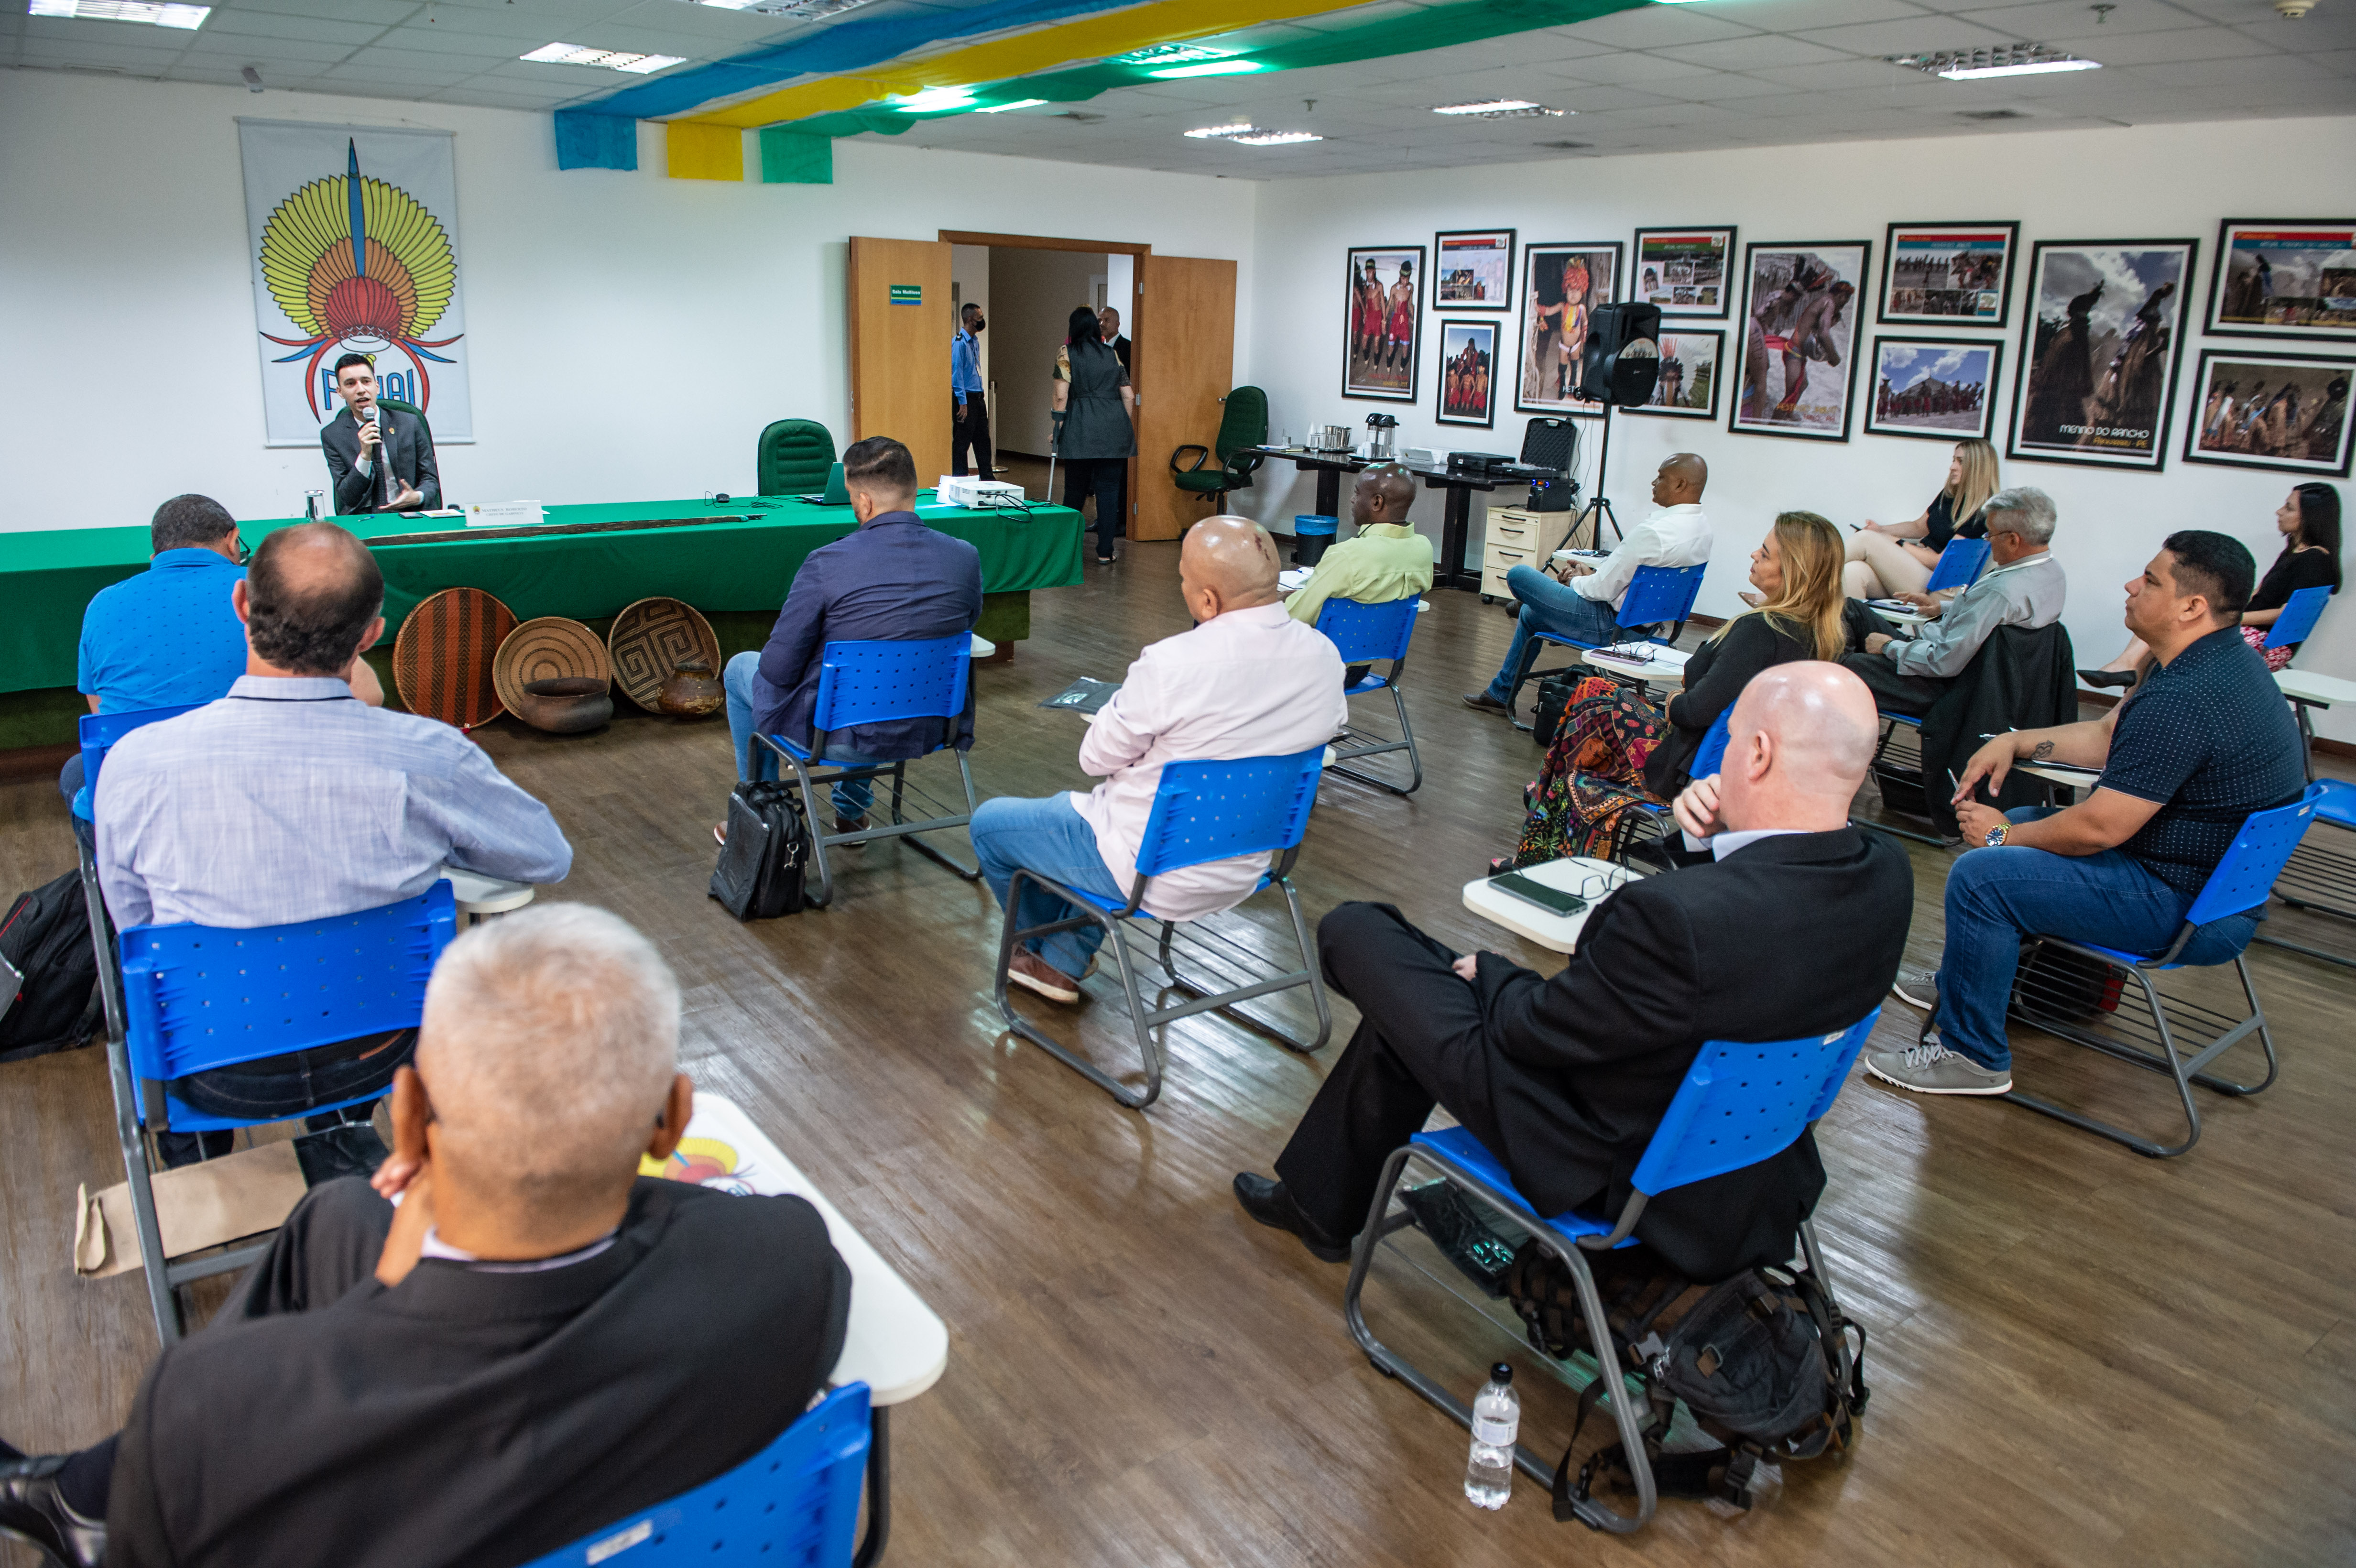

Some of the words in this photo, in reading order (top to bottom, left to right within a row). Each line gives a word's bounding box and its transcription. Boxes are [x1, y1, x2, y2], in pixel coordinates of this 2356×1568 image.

[321, 368, 415, 410] FAI
[2060, 425, 2095, 435] MENINO
[2095, 426, 2110, 436] DO
[2110, 428, 2149, 439] RANCHO
